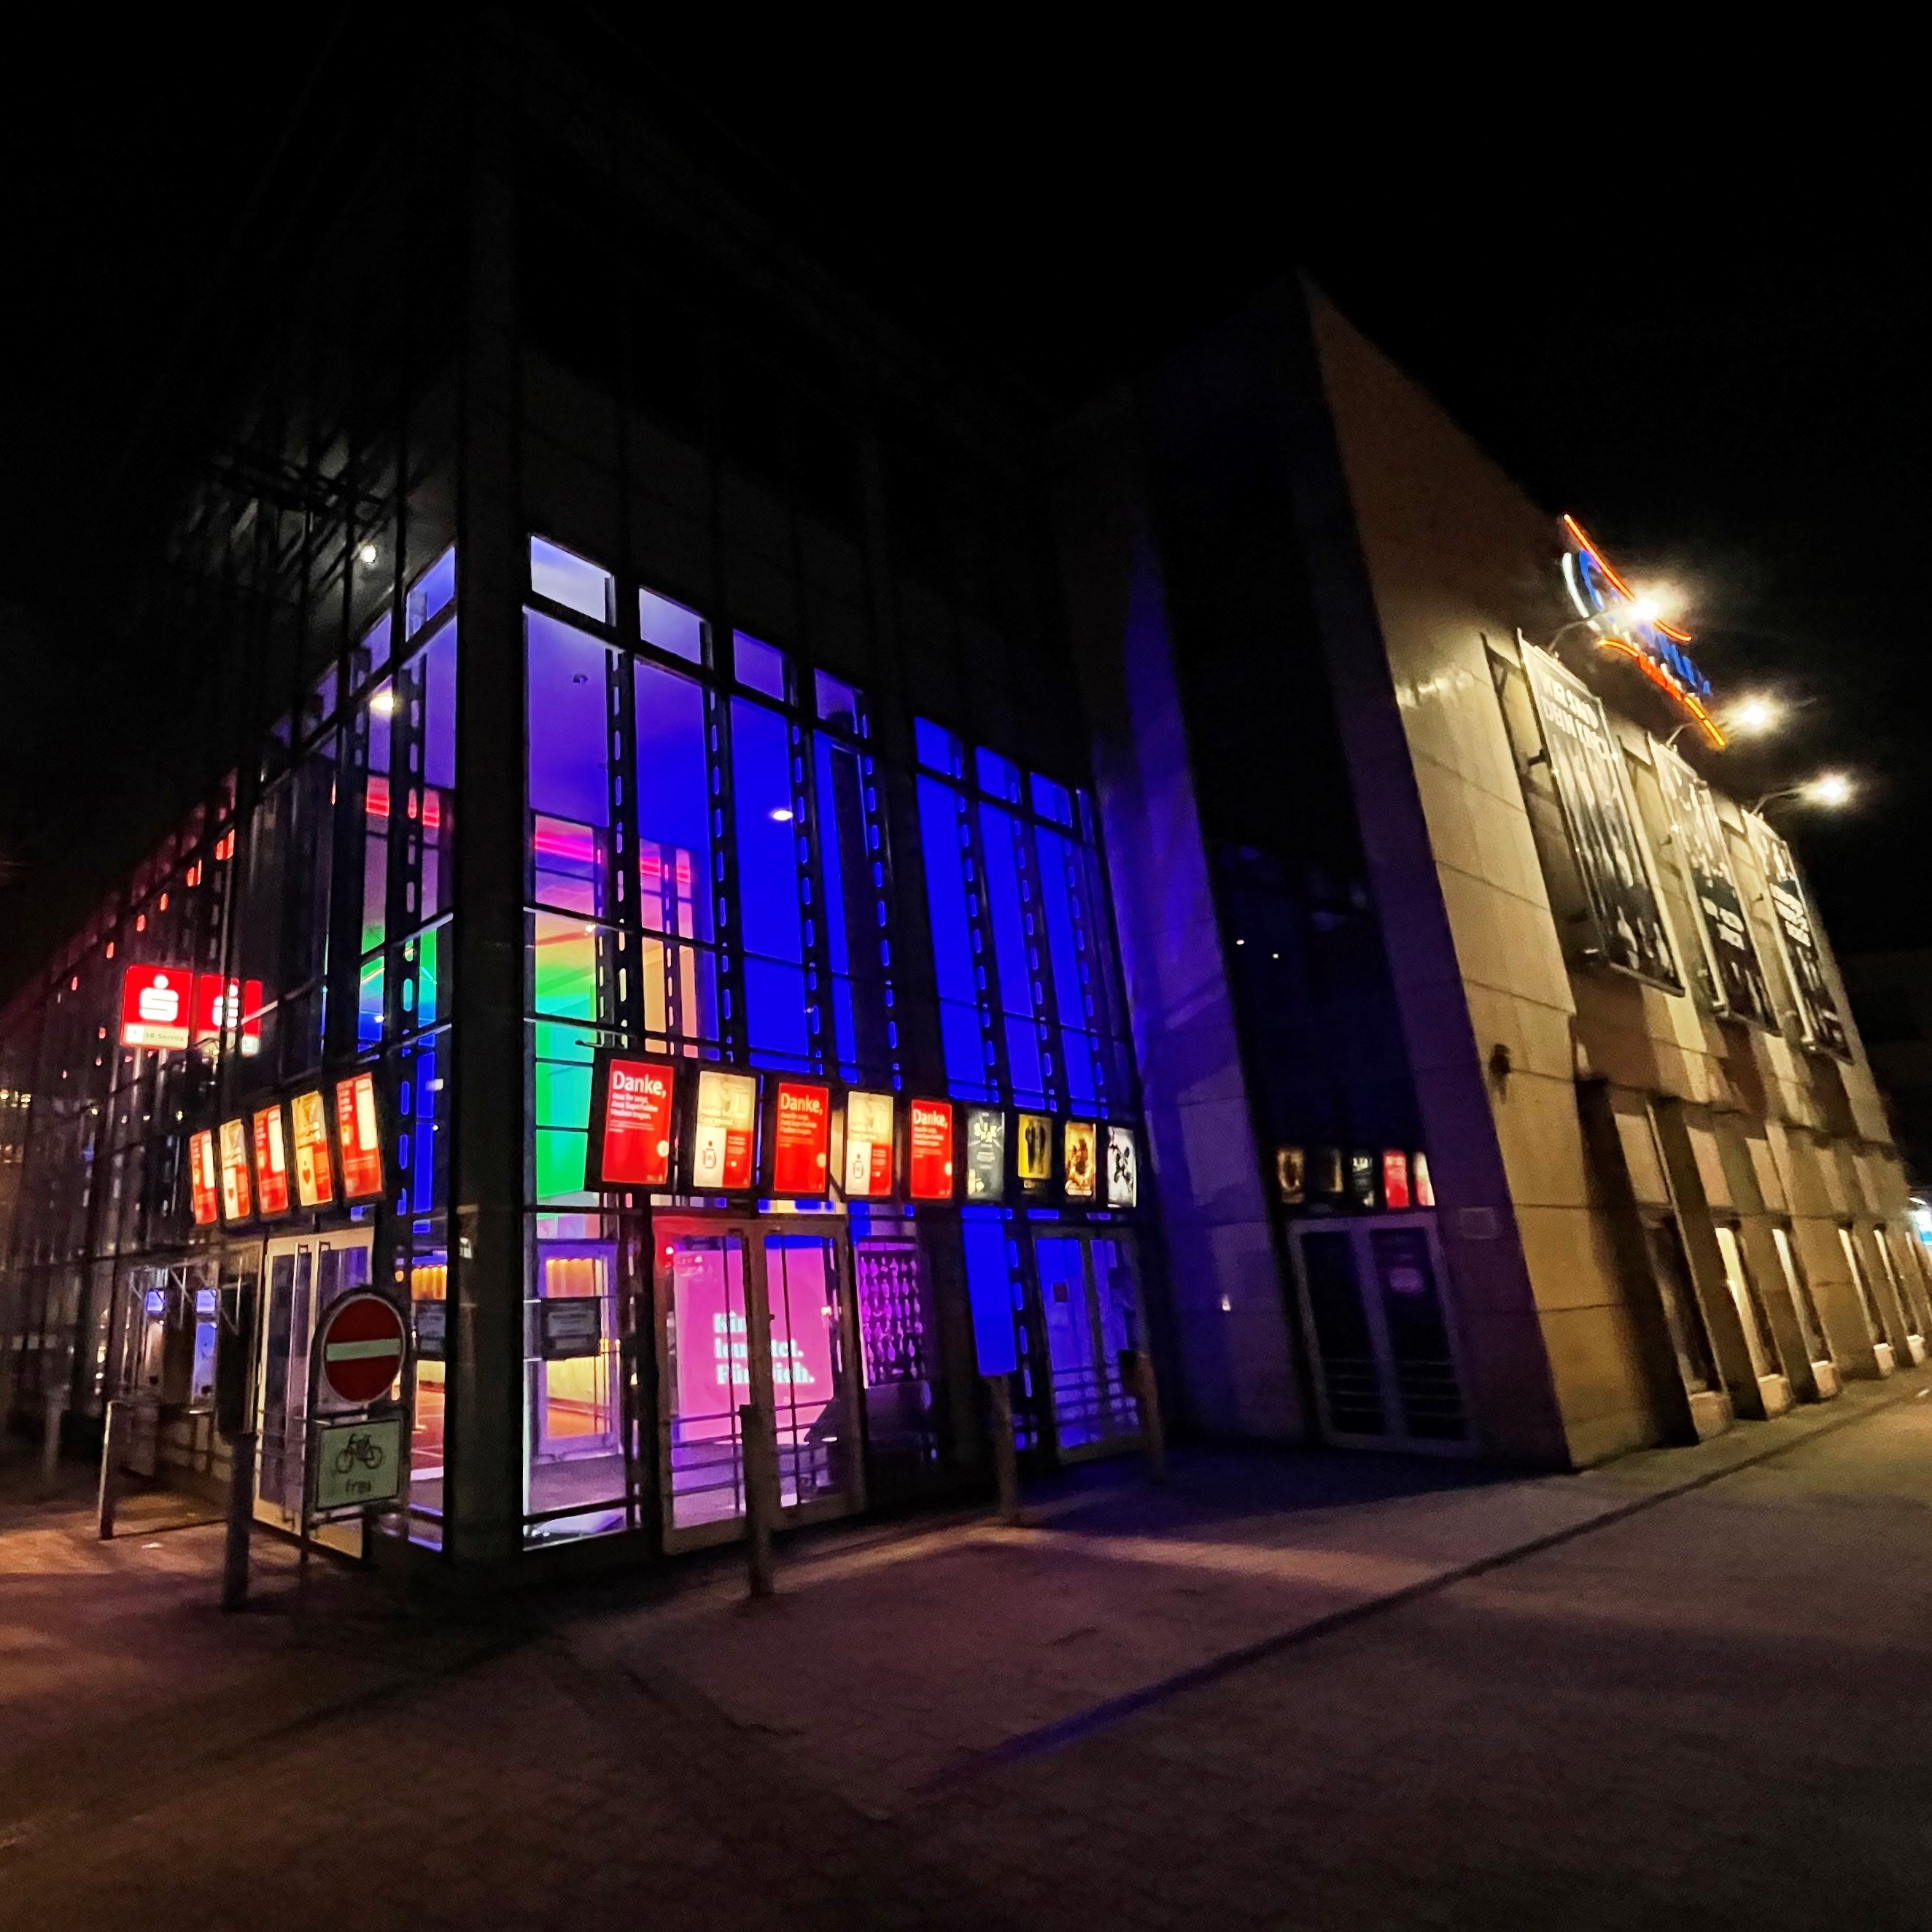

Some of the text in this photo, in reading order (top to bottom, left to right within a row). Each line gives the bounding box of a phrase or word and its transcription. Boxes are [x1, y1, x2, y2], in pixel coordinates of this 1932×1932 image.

[613, 1071, 666, 1098] Danke,
[781, 1093, 823, 1115] Danke,
[913, 1109, 947, 1129] Danke,
[715, 1338, 804, 1358] leutet.
[772, 1362, 814, 1384] ich.
